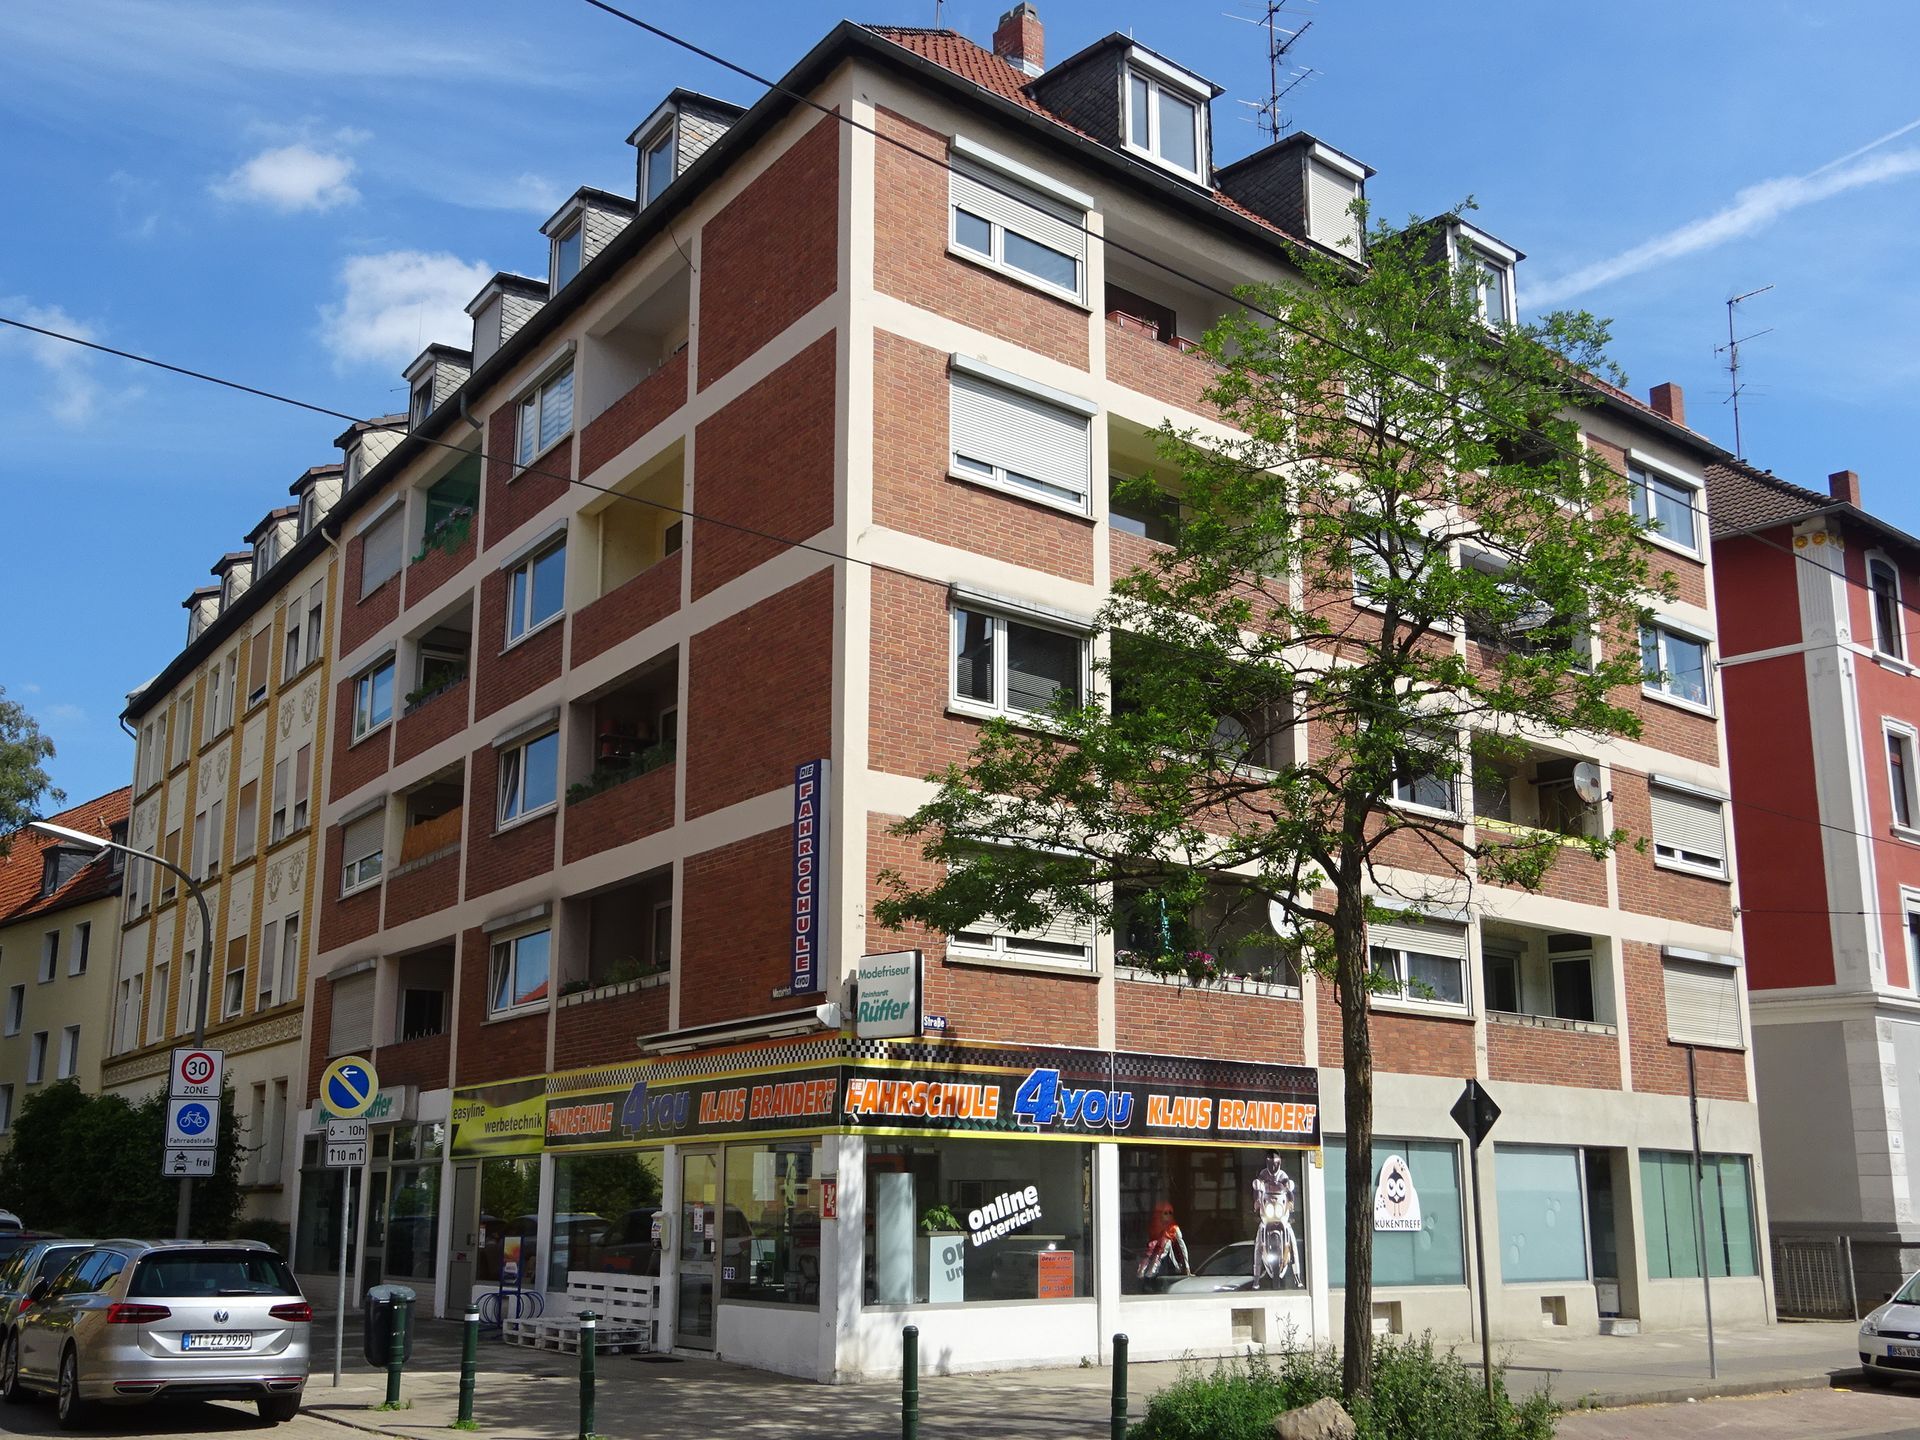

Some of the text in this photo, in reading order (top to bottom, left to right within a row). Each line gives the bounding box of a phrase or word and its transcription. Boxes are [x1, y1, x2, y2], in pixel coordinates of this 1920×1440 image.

[799, 764, 814, 780] DIE
[795, 780, 814, 972] FAHRSCHULE
[858, 965, 910, 980] Modefriseur
[861, 990, 889, 998] Reinhardt
[858, 998, 910, 1023] Rüffer
[923, 1016, 945, 1028] Straße
[188, 1062, 208, 1076] 30
[183, 1086, 209, 1095] ZONE
[844, 1079, 1000, 1119] FAHRSCHULE
[453, 1102, 486, 1122] easyline
[546, 1102, 614, 1137] FAHRSCHULE
[698, 1087, 748, 1124] KLAUS
[749, 1078, 837, 1120] BRANDERT
[1146, 1094, 1213, 1129] KLAUS
[1218, 1099, 1317, 1134] BRANDERT
[329, 1126, 336, 1136] 6
[348, 1125, 365, 1135] 10h
[484, 1113, 543, 1134] werbetechnik
[169, 1137, 214, 1145] Fahrradstraße
[196, 1157, 211, 1167] frei
[337, 1150, 346, 1161] 10
[968, 1185, 1039, 1230] online
[971, 1204, 1042, 1247] Unterricht
[1375, 1217, 1421, 1229] KÜKENTREFF
[210, 1334, 223, 1345] ZZ
[226, 1334, 250, 1345] 9999
